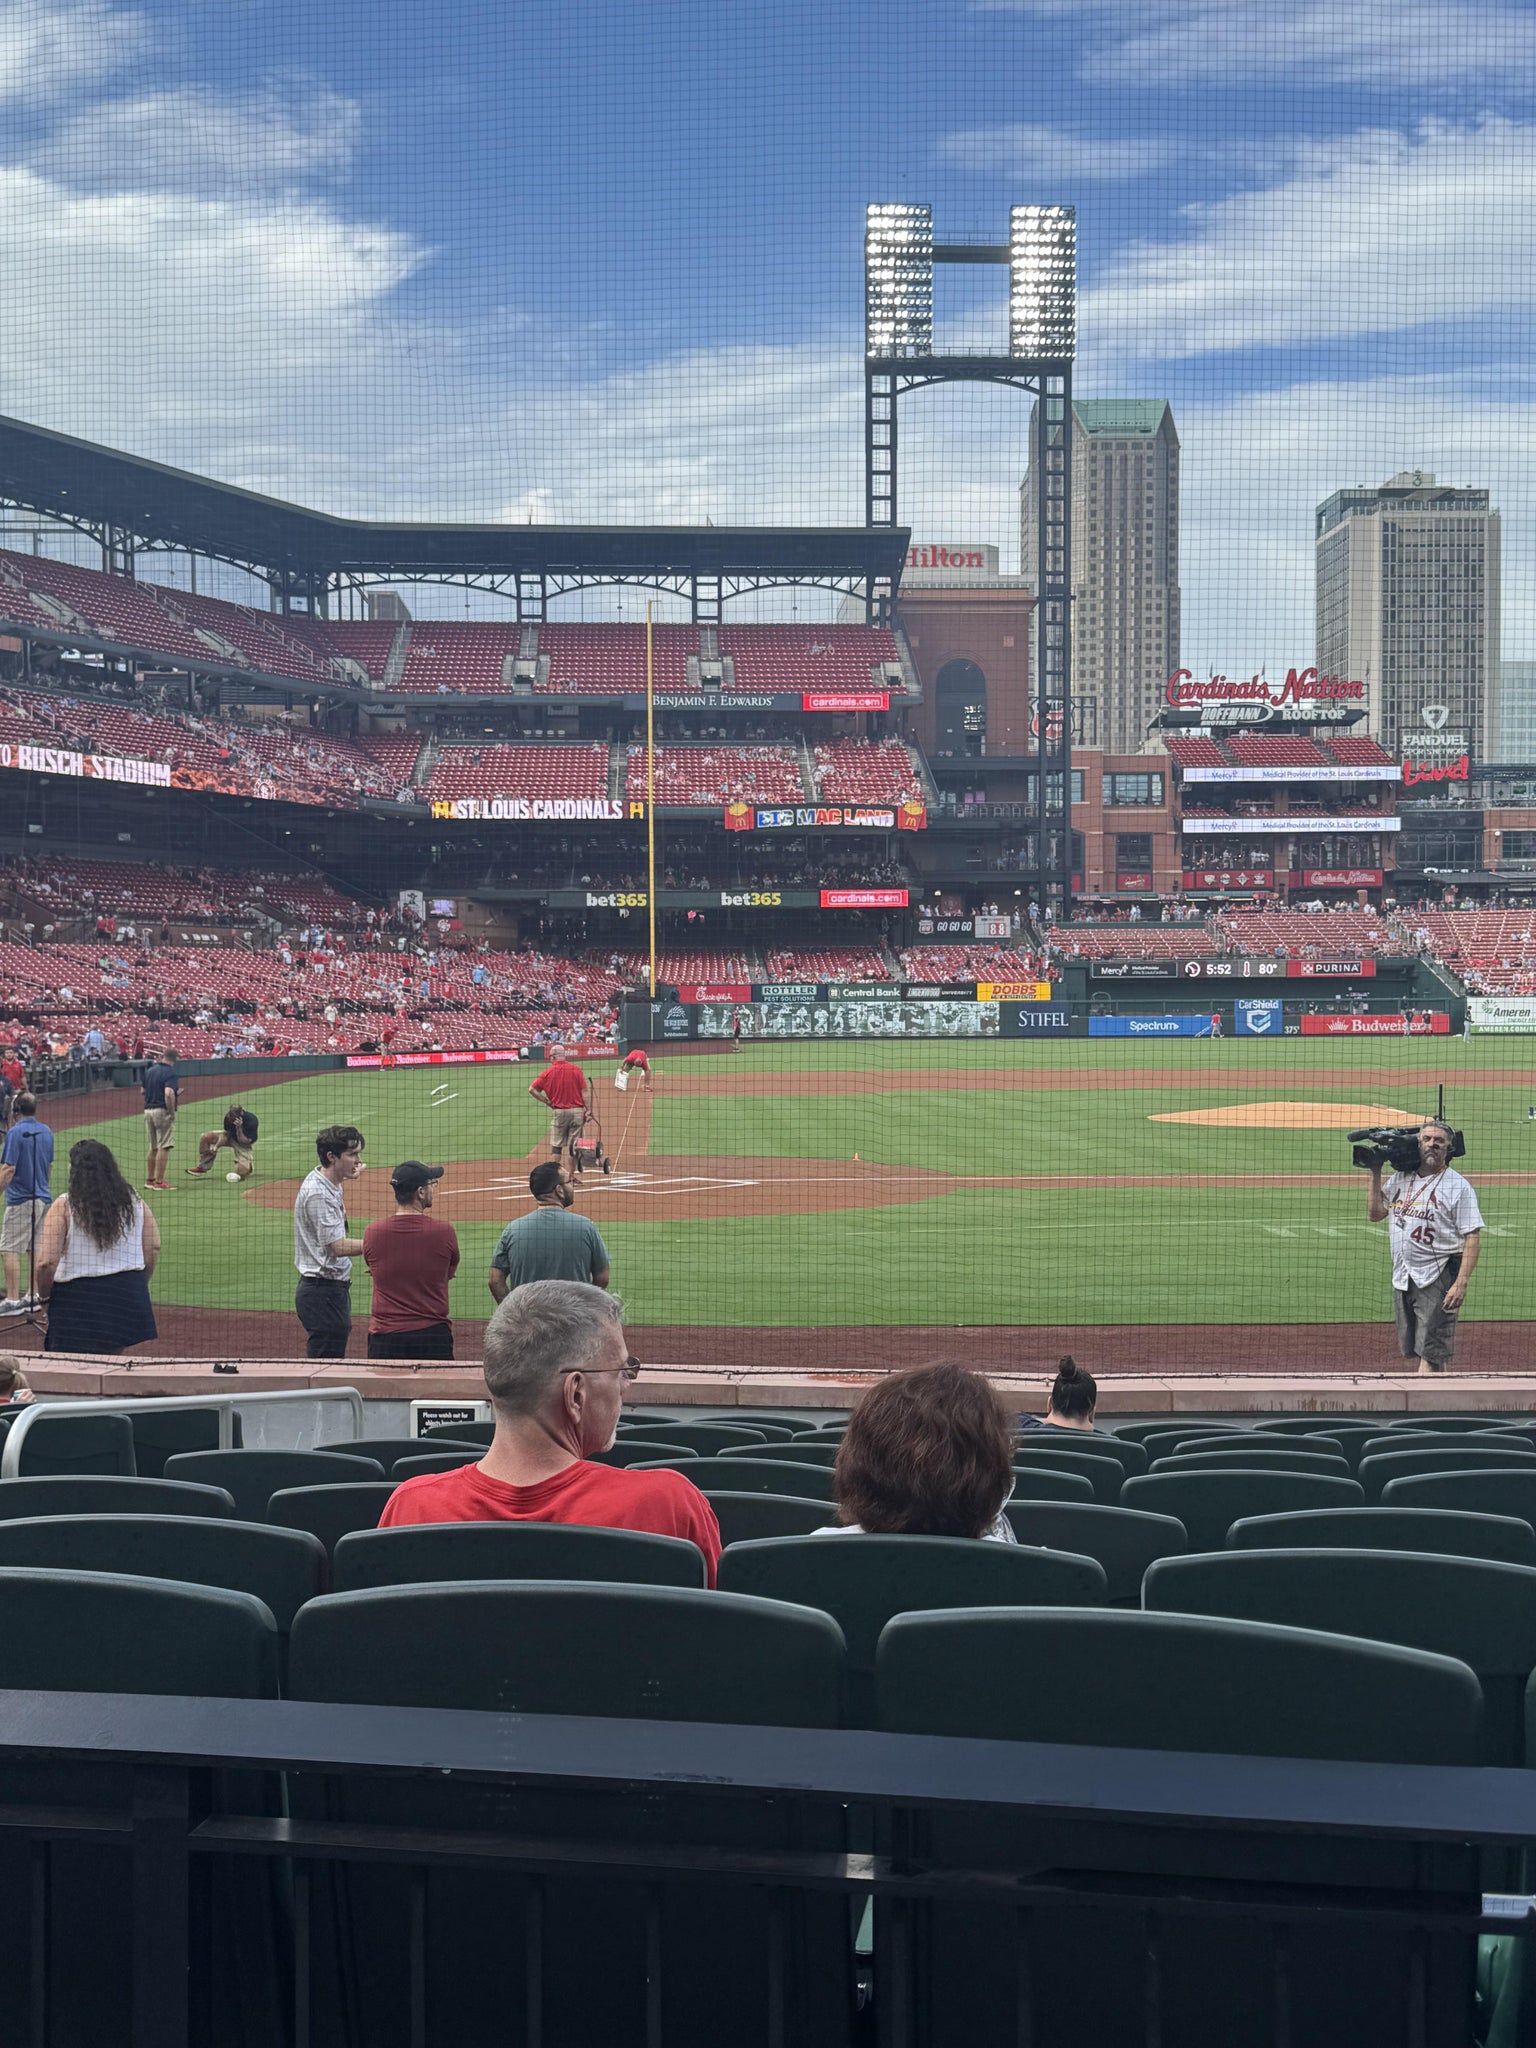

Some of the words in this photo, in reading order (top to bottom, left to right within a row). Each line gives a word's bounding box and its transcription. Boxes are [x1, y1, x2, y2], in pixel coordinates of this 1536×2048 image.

[905, 545, 983, 568] Hilton
[1166, 669, 1271, 707] Cardinals
[1270, 667, 1365, 706] Nation
[652, 694, 706, 706] BENJAMIN
[708, 695, 718, 705] F.
[812, 695, 881, 707] cardinals.com
[1201, 706, 1262, 721] HOFFMANN
[1282, 709, 1346, 721] ROOFTOP
[1402, 734, 1469, 746] FANDUEL
[0, 744, 12, 767] O
[18, 744, 84, 776] BUSCH
[91, 755, 171, 787] STADIUM
[1211, 771, 1233, 780] Mercy
[1262, 770, 1286, 778] Medical
[1287, 770, 1310, 778] Provider
[1354, 769, 1381, 777] Cardinals
[457, 800, 480, 819] ST.
[481, 800, 530, 819] LOUIS
[532, 800, 623, 819] CARDINALS
[757, 810, 793, 828] BIG
[796, 808, 841, 827] MAC
[844, 808, 894, 827] LAND
[1211, 823, 1232, 831] Mercy
[586, 892, 647, 907] bet365
[721, 891, 781, 906] bet365
[830, 893, 900, 904] cardinals.com
[937, 921, 948, 932] GO
[949, 921, 960, 932] GO
[961, 921, 972, 932] GO
[1101, 967, 1123, 976] Mercy
[1206, 964, 1232, 975] 5:52
[1315, 964, 1359, 974] PURINA
[764, 986, 814, 994] ROTTLER
[842, 987, 875, 997] Central
[876, 987, 900, 997] Bank
[992, 984, 1037, 995] DOBBS
[1238, 1000, 1279, 1010] CarShield
[1493, 1007, 1531, 1017] Ameren
[1018, 1010, 1069, 1027] STIFEL
[1129, 1020, 1175, 1032] Spectrum
[1410, 1226, 1436, 1246] 45
